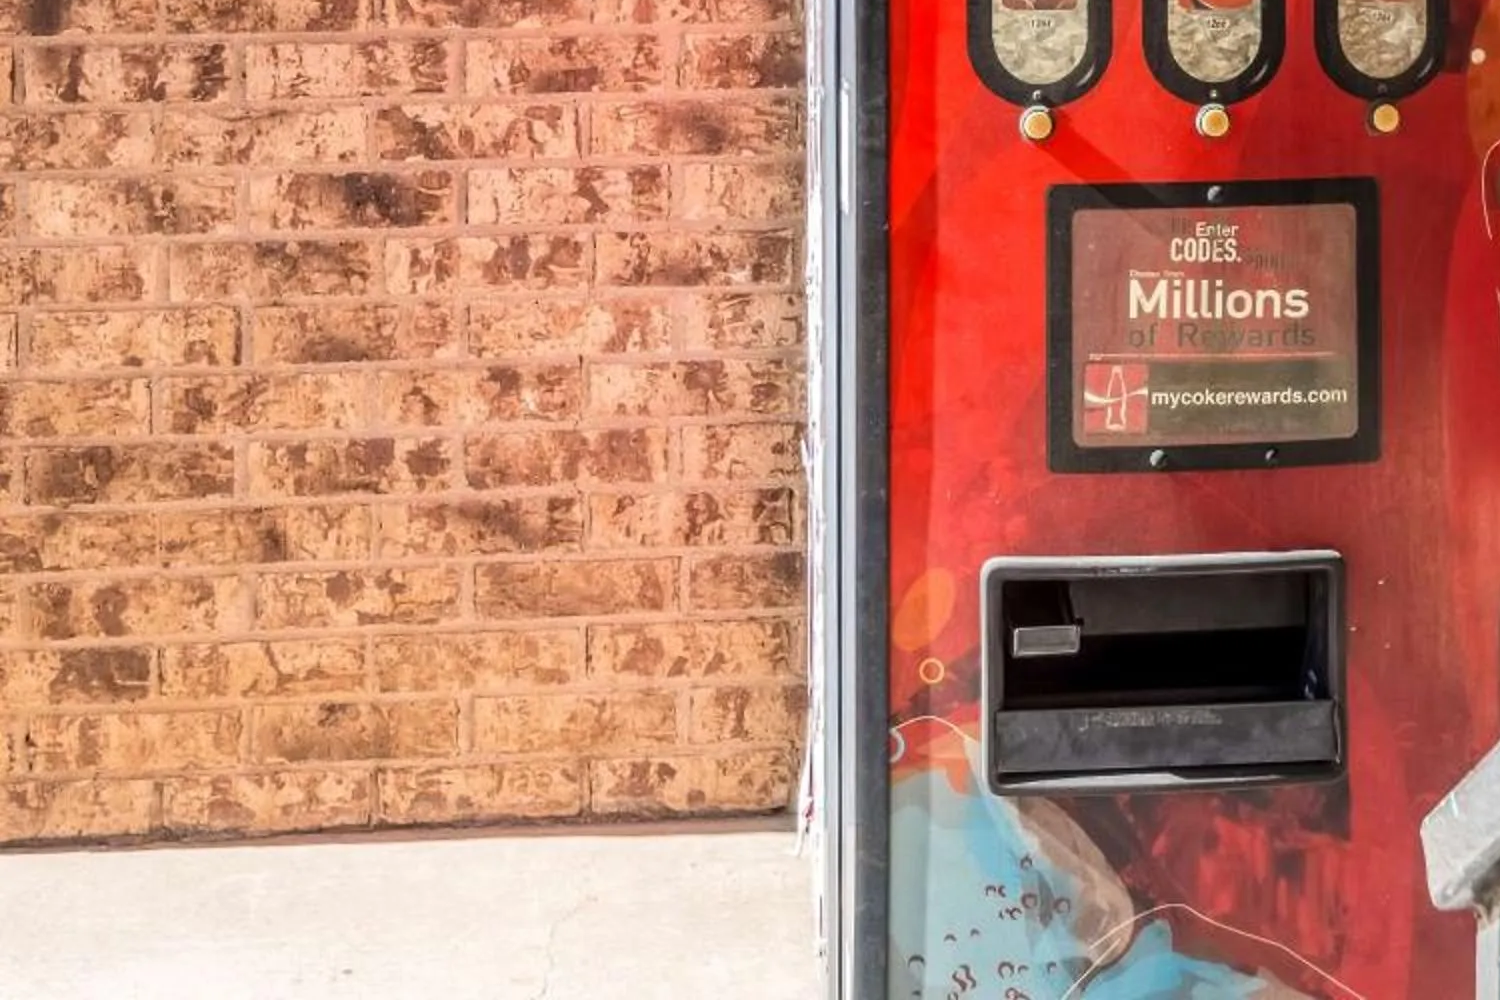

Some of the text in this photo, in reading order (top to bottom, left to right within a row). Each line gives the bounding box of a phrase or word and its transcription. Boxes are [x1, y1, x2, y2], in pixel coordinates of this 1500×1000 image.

[1195, 221, 1239, 237] Enter
[1170, 237, 1242, 263] CODES.
[1129, 279, 1310, 319] Millions
[1129, 322, 1316, 348] of Rewards
[1151, 387, 1348, 409] mycokerewards.com
